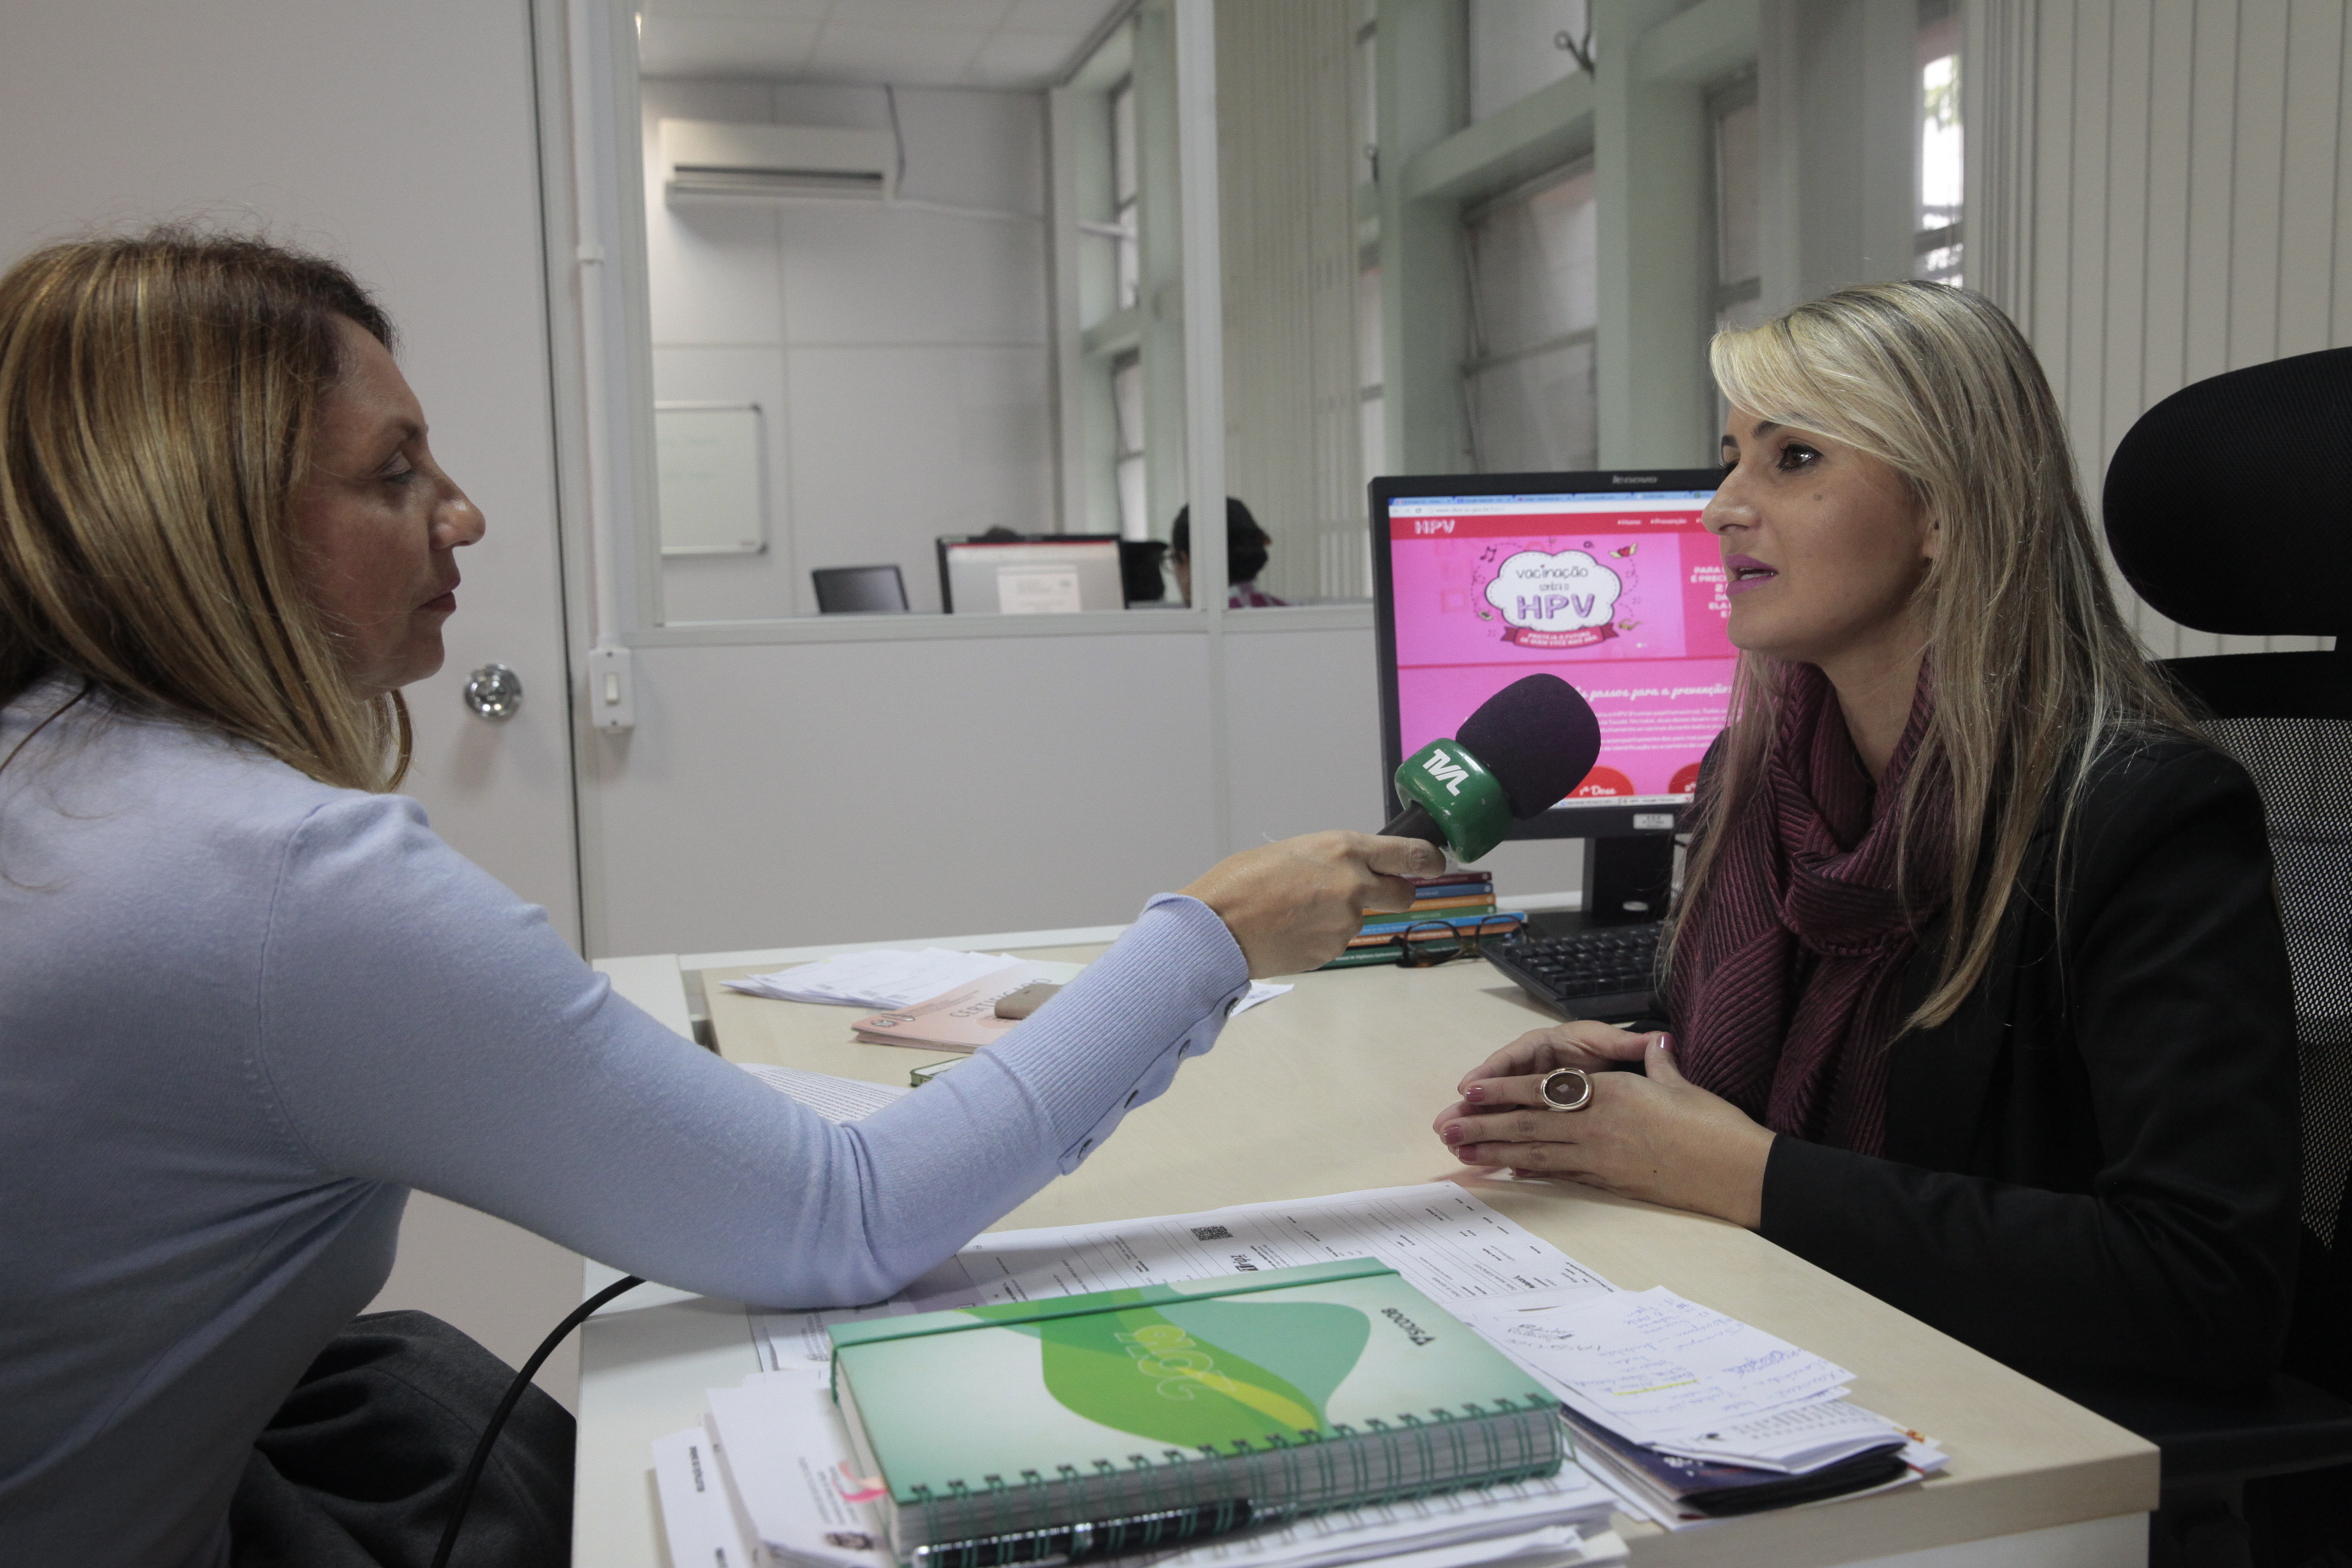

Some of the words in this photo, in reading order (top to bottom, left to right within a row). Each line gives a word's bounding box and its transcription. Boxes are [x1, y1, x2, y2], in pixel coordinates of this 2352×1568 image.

[1414, 520, 1456, 535] HPV
[1515, 564, 1589, 580] vacinação
[1516, 593, 1595, 620] HPV
